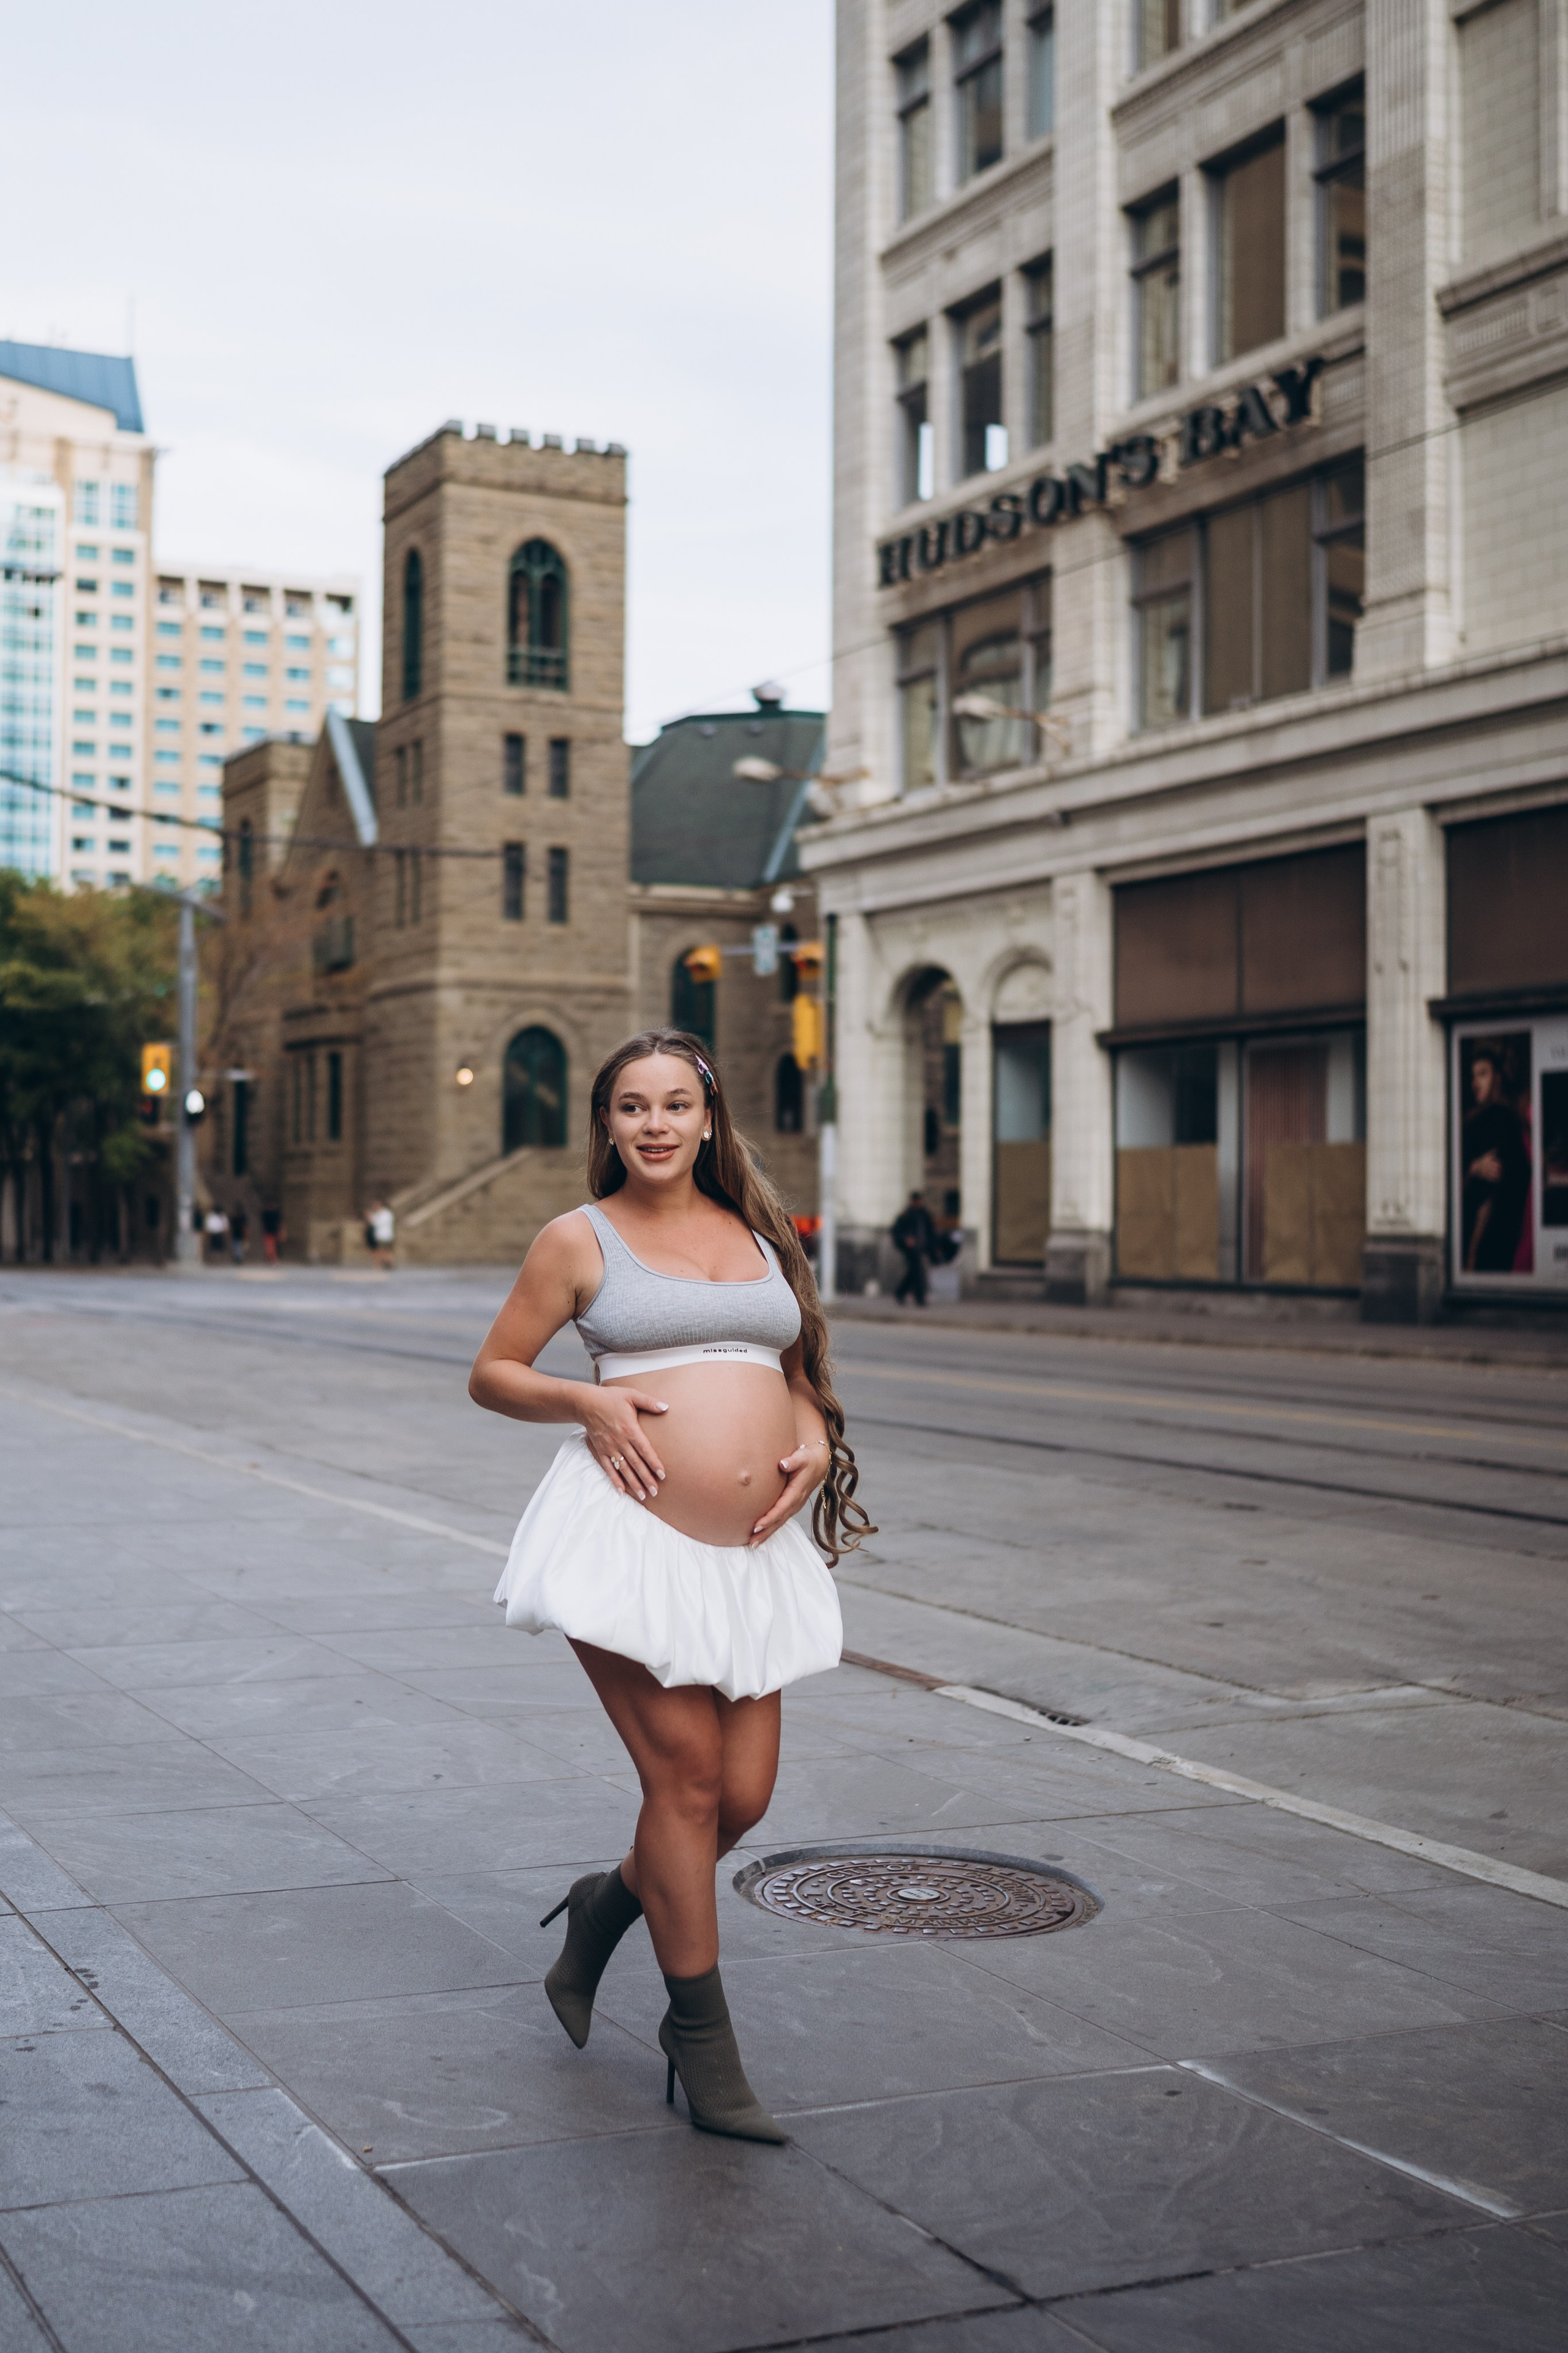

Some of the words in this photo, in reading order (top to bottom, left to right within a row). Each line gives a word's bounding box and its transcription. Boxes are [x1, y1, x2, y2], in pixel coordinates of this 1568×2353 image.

[875, 434, 1159, 589] HUDSON'S
[1178, 357, 1326, 468] BAY
[827, 1867, 872, 1878] CITY
[962, 1872, 1036, 1903] CALGARY
[895, 1911, 1020, 1926] MANHOLE
